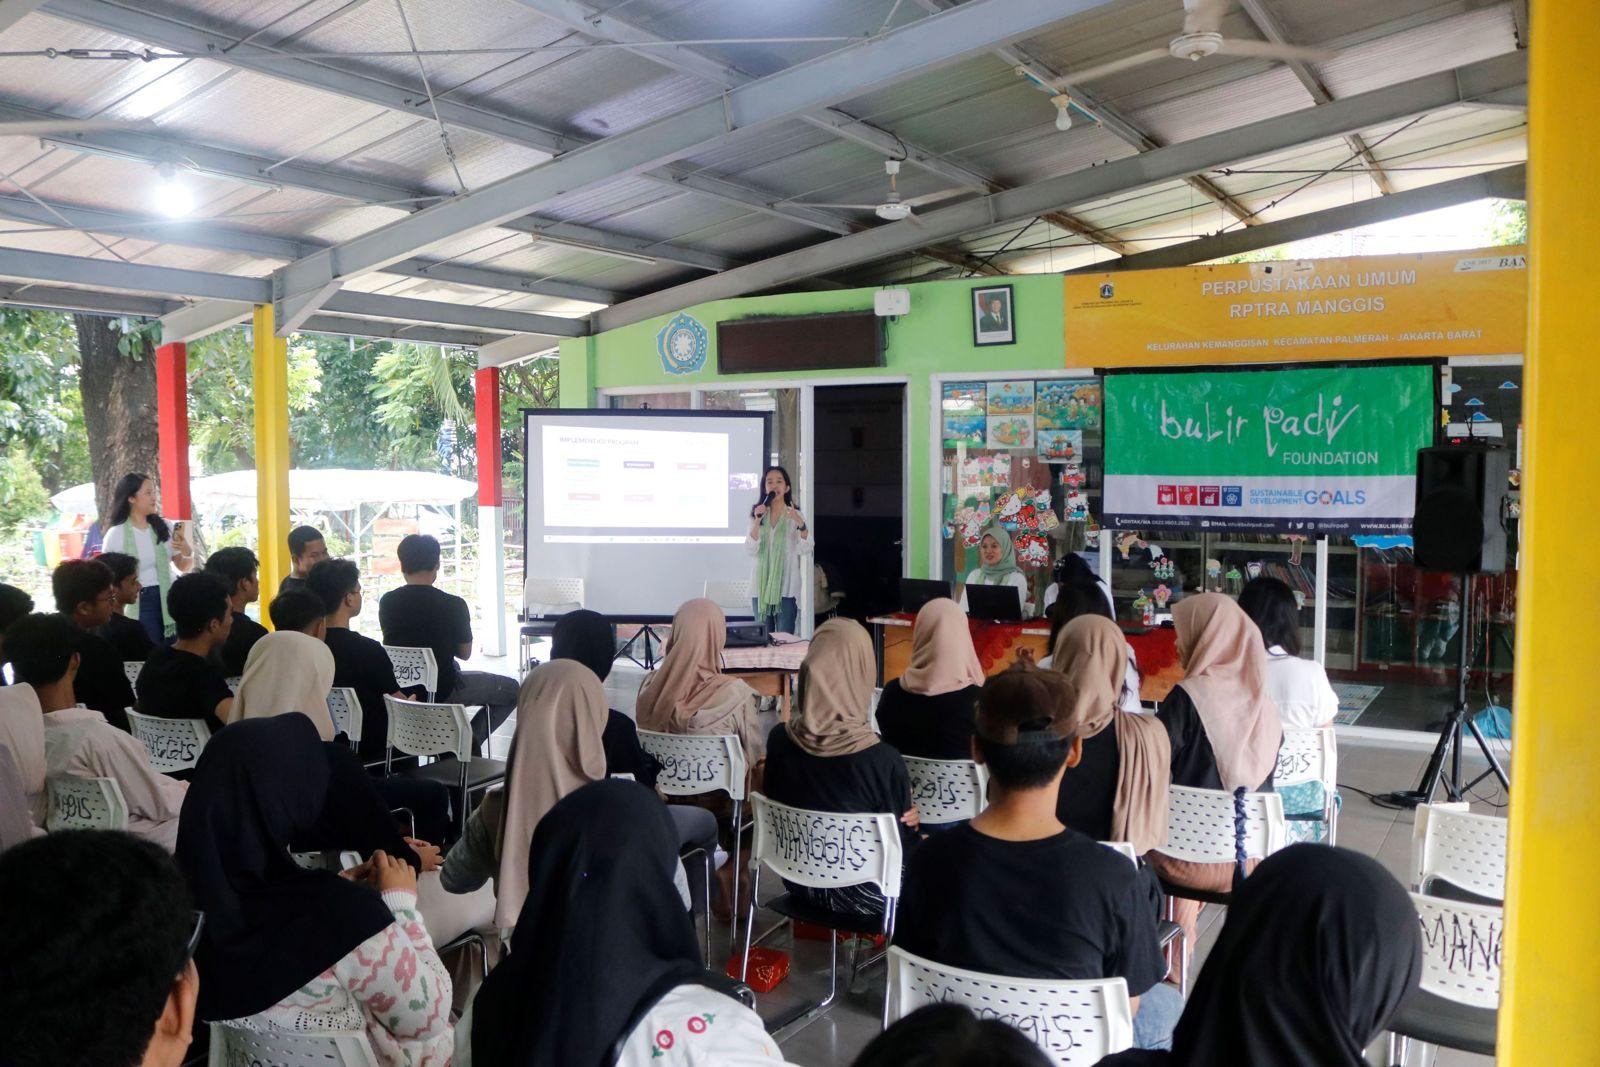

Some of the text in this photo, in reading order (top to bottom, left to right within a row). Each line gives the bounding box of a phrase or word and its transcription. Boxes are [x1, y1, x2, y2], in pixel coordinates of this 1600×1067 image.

[1201, 270, 1416, 296] PERPUSTAKAAN UMUM
[1229, 296, 1385, 318] RPTRA MANGGIS
[1146, 341, 1200, 351] KELURAHAN
[1202, 338, 1268, 349] KEMANGGISAN
[1274, 335, 1332, 346] KECAMATAN
[1335, 333, 1389, 344] PALMERAH
[1397, 330, 1443, 341] JAKARTA
[1446, 328, 1483, 340] BARAT
[1283, 451, 1379, 465] FOUNDATION
[1250, 489, 1303, 497] SUSTAINABLE
[1304, 490, 1367, 505] GOALS
